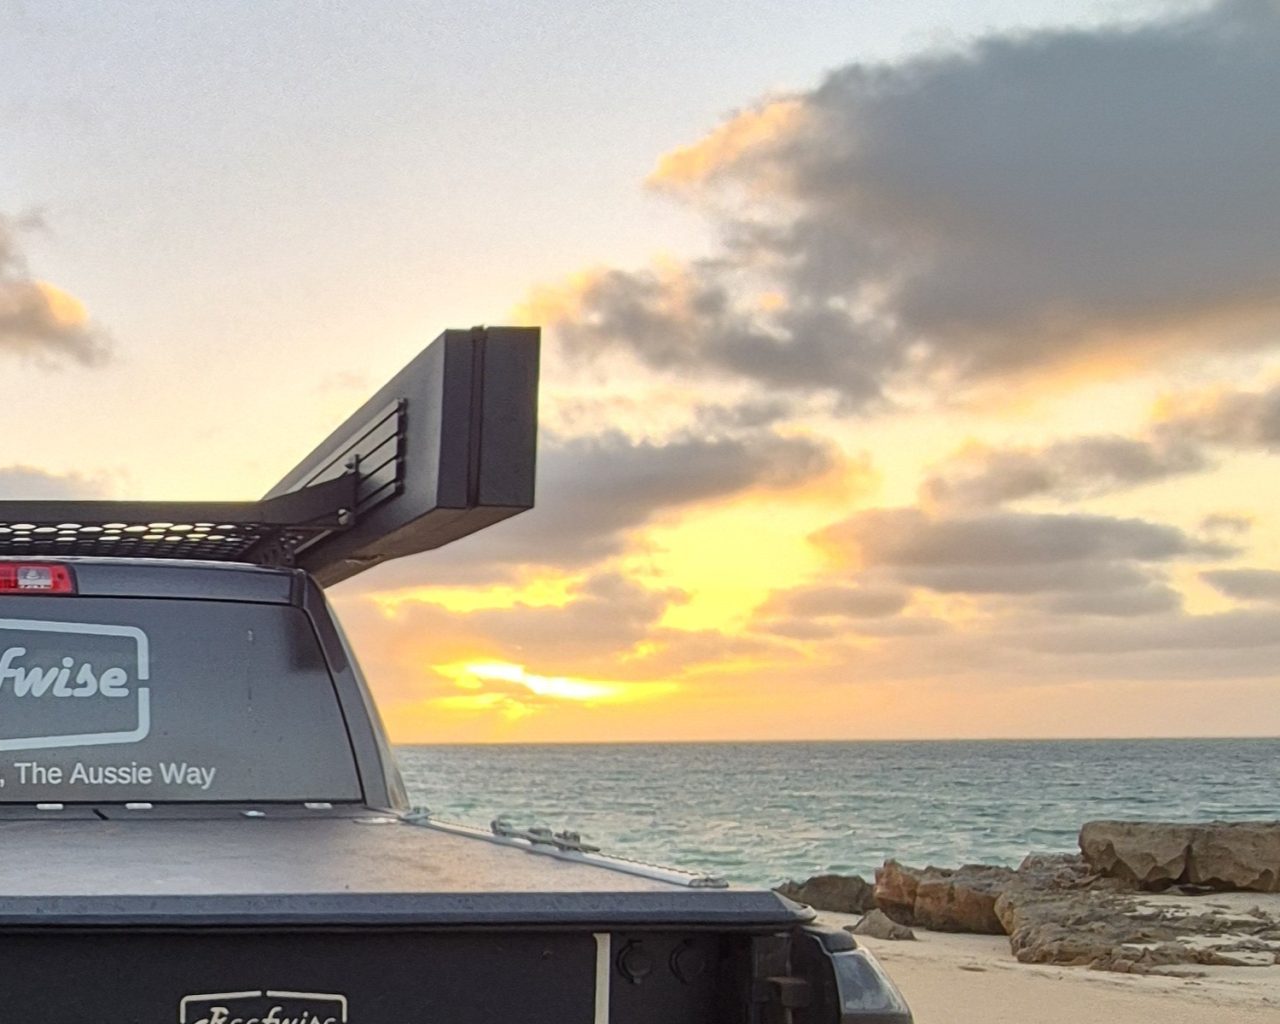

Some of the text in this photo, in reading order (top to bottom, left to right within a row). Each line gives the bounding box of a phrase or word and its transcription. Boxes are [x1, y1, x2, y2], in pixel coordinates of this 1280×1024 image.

[14, 762, 64, 785] The
[70, 761, 153, 785] Aussie
[159, 761, 217, 790] Way
